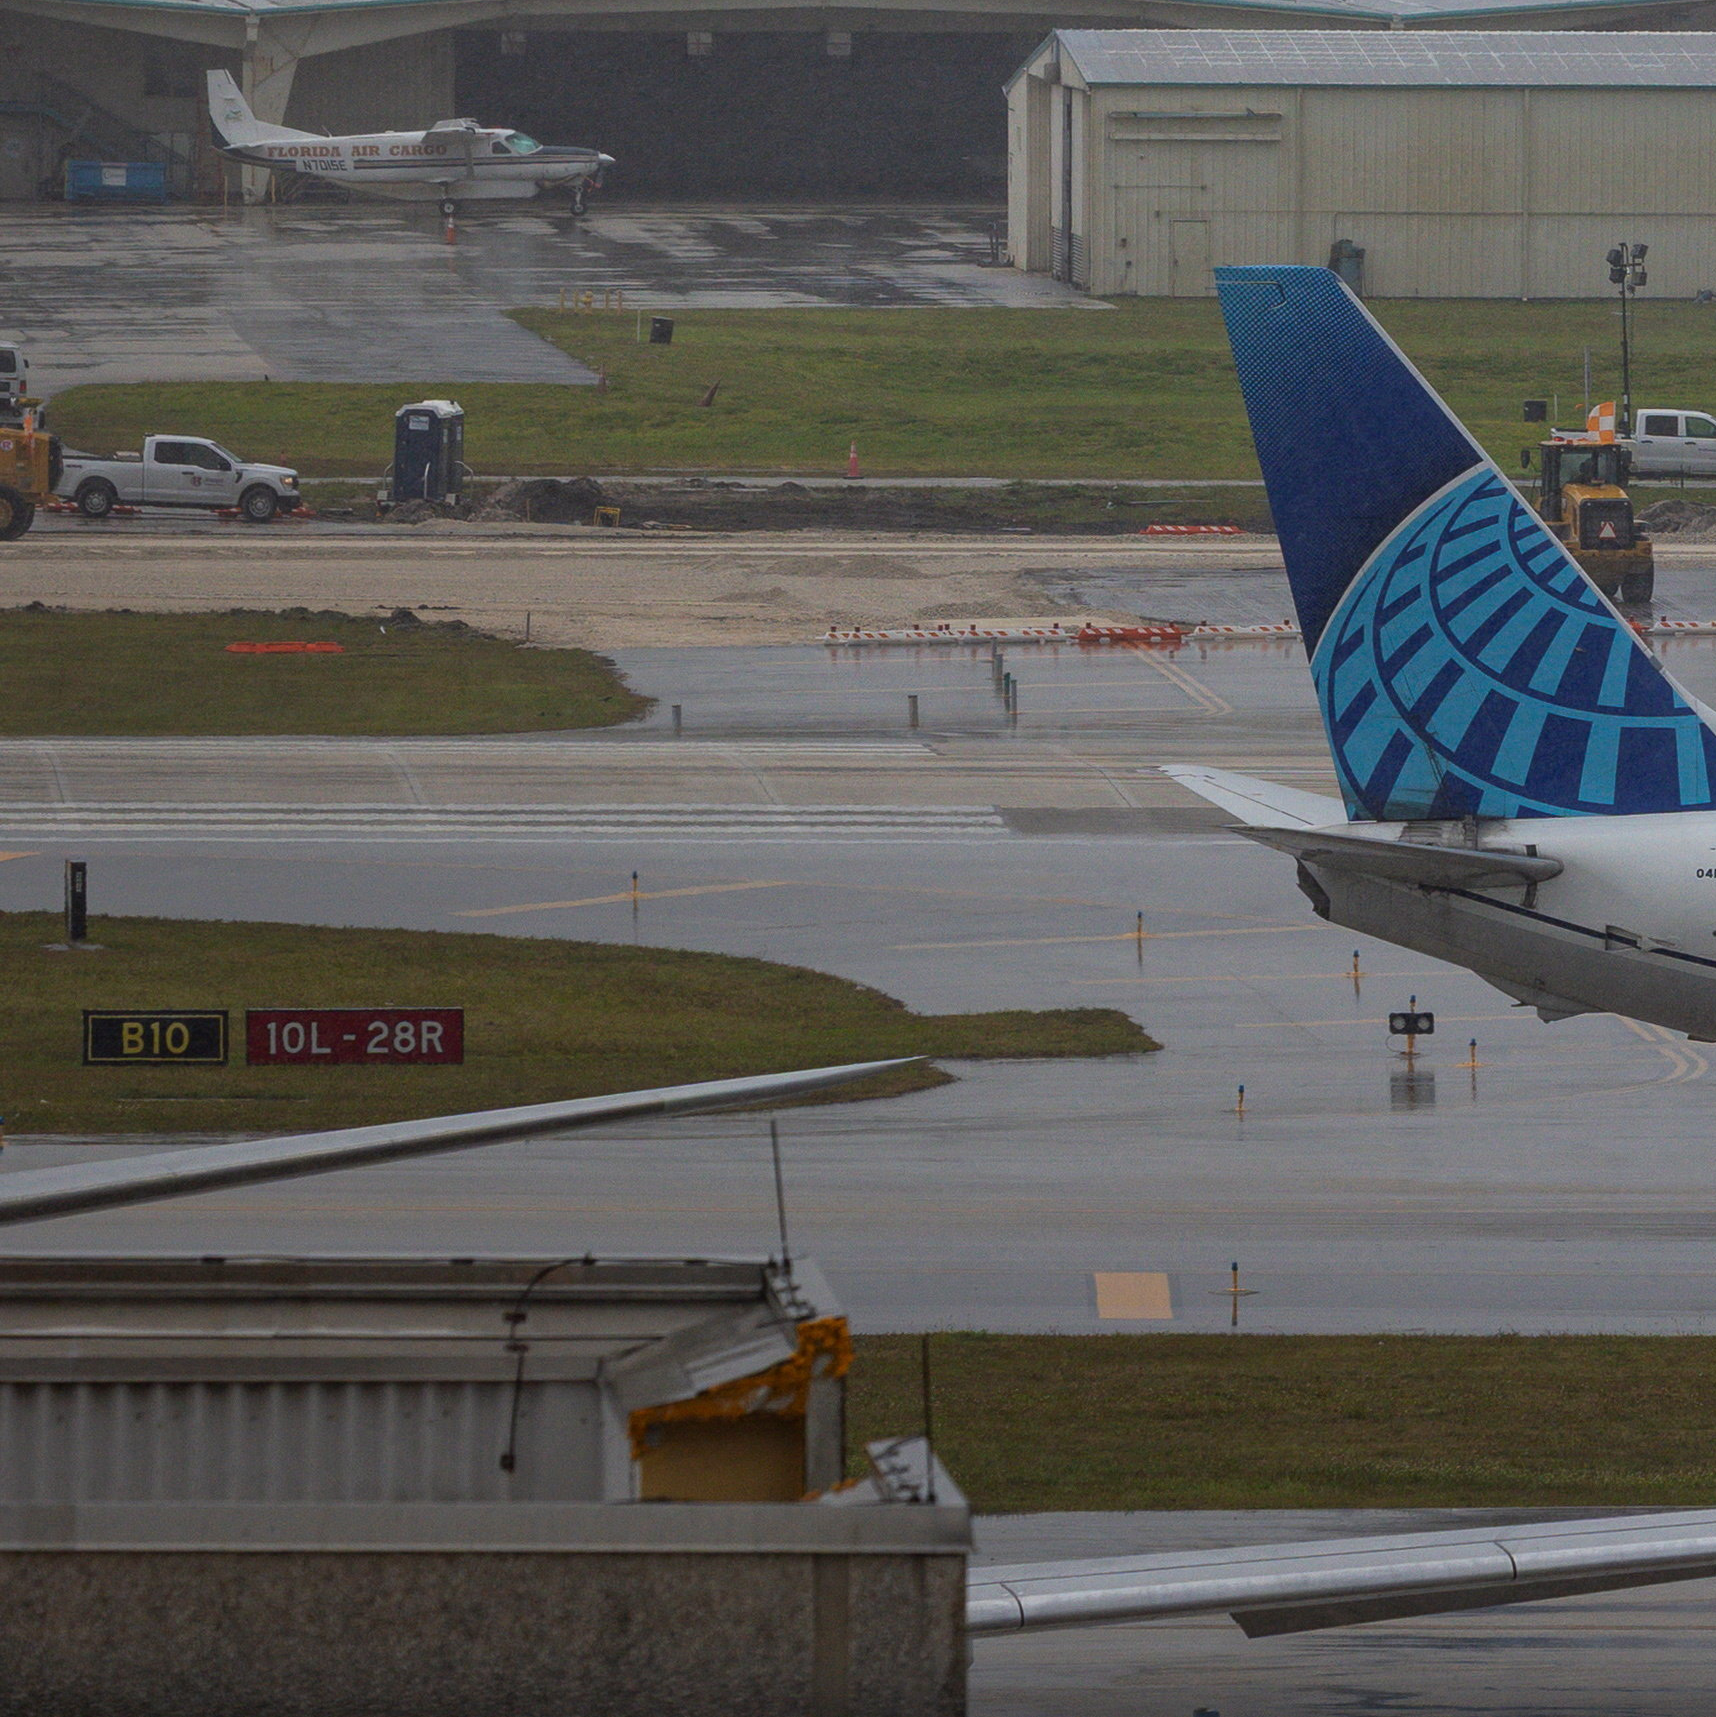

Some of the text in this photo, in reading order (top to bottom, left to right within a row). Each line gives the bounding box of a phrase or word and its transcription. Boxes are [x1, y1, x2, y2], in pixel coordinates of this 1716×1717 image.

[267, 144, 448, 157] FLORIDA AIR CARGO
[122, 1021, 190, 1054] B10
[267, 1021, 331, 1055] 10L
[366, 1020, 444, 1054] 28R
